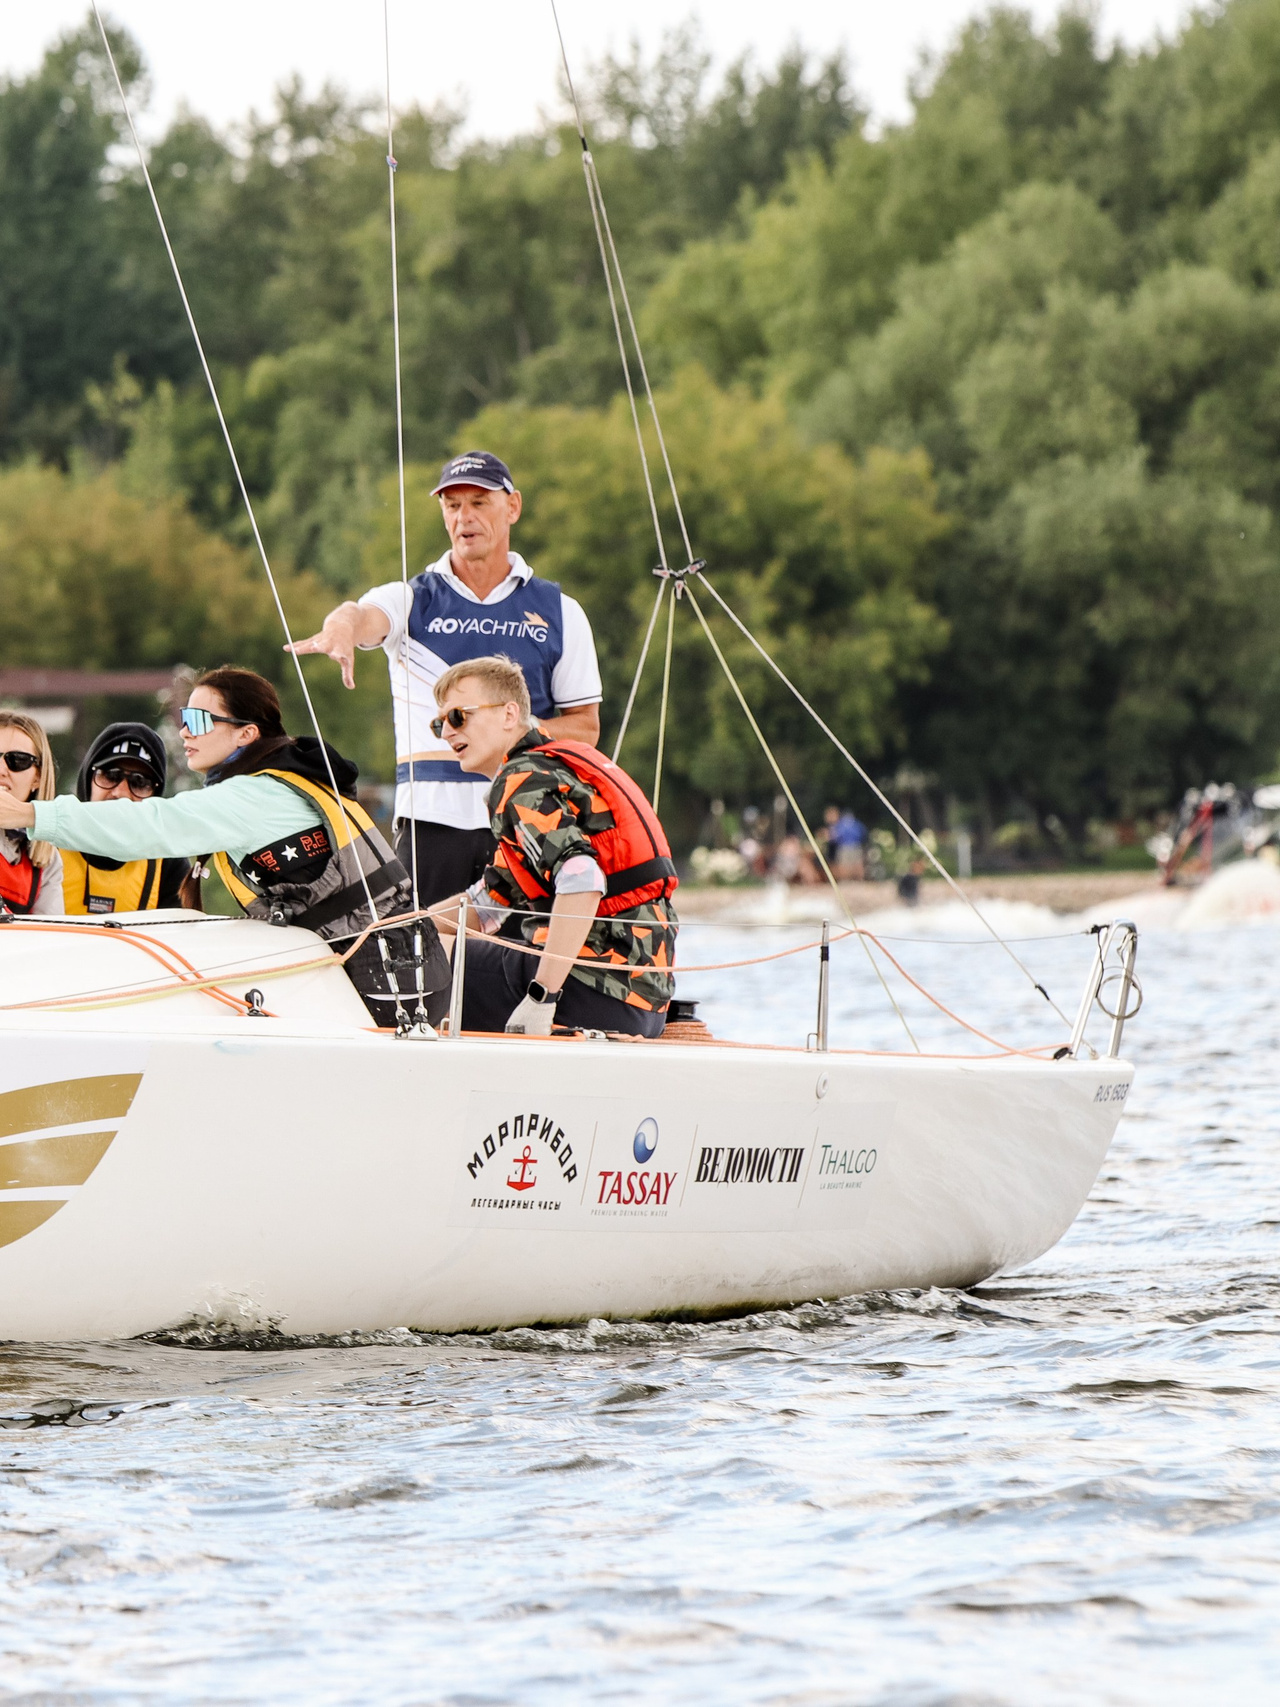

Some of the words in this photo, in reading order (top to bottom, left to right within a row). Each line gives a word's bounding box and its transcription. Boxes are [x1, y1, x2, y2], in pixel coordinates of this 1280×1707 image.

[426, 617, 548, 643] ROYACHTING
[466, 1113, 578, 1184] МОРПРИБОР
[694, 1147, 805, 1188] ВЕДОМОСТИ
[471, 1198, 534, 1210] ЛЕГЕНДАРНЫЕ
[538, 1200, 561, 1210] ЧАСЫ
[597, 1171, 678, 1205] TASSAY
